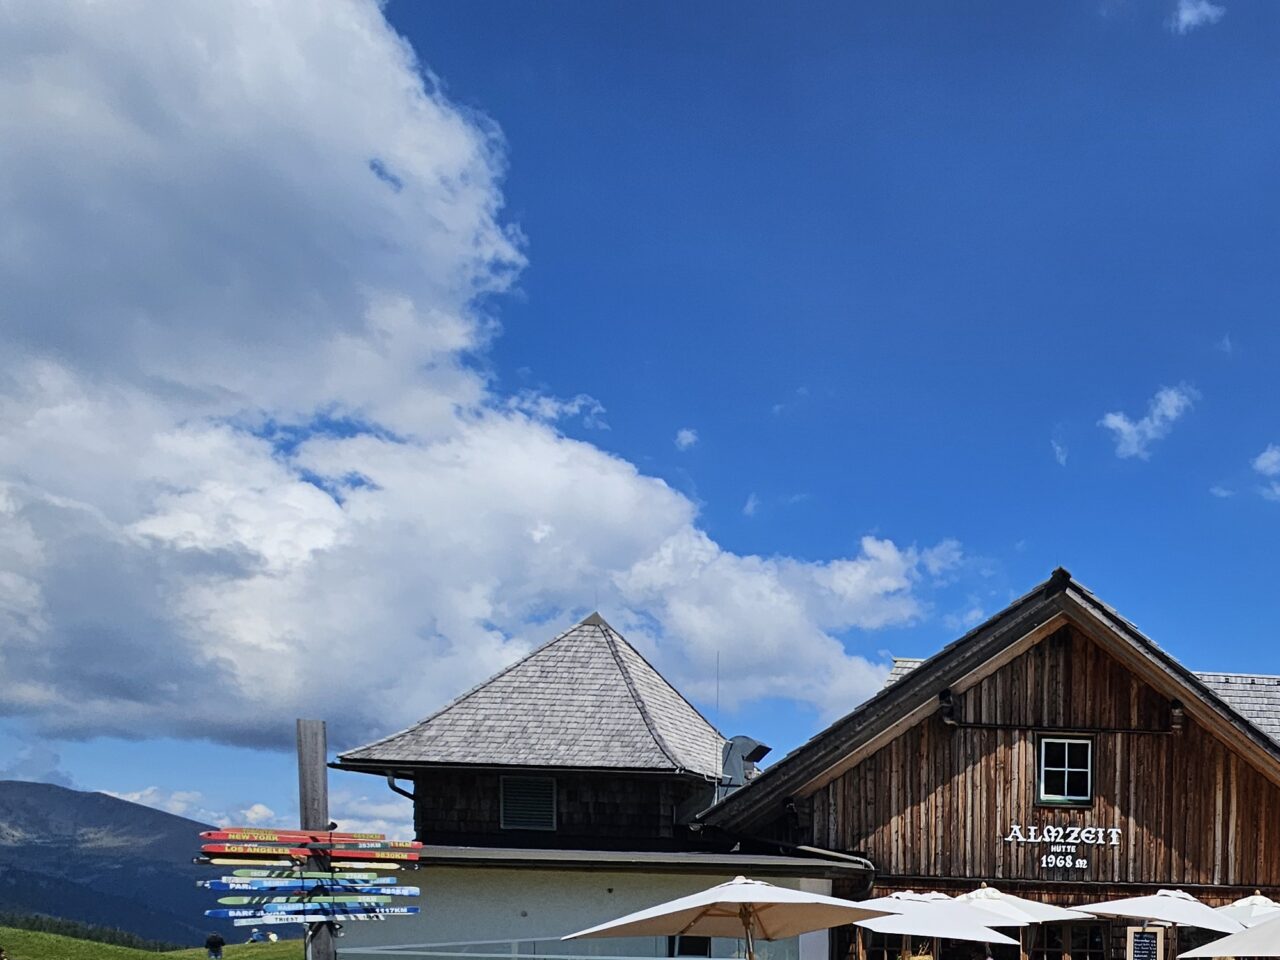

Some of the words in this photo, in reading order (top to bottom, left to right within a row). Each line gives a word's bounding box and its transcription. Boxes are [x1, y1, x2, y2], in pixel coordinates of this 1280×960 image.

[253, 833, 279, 841] YORK
[1005, 825, 1122, 845] ALMZEIT
[1041, 855, 1073, 868] 1968
